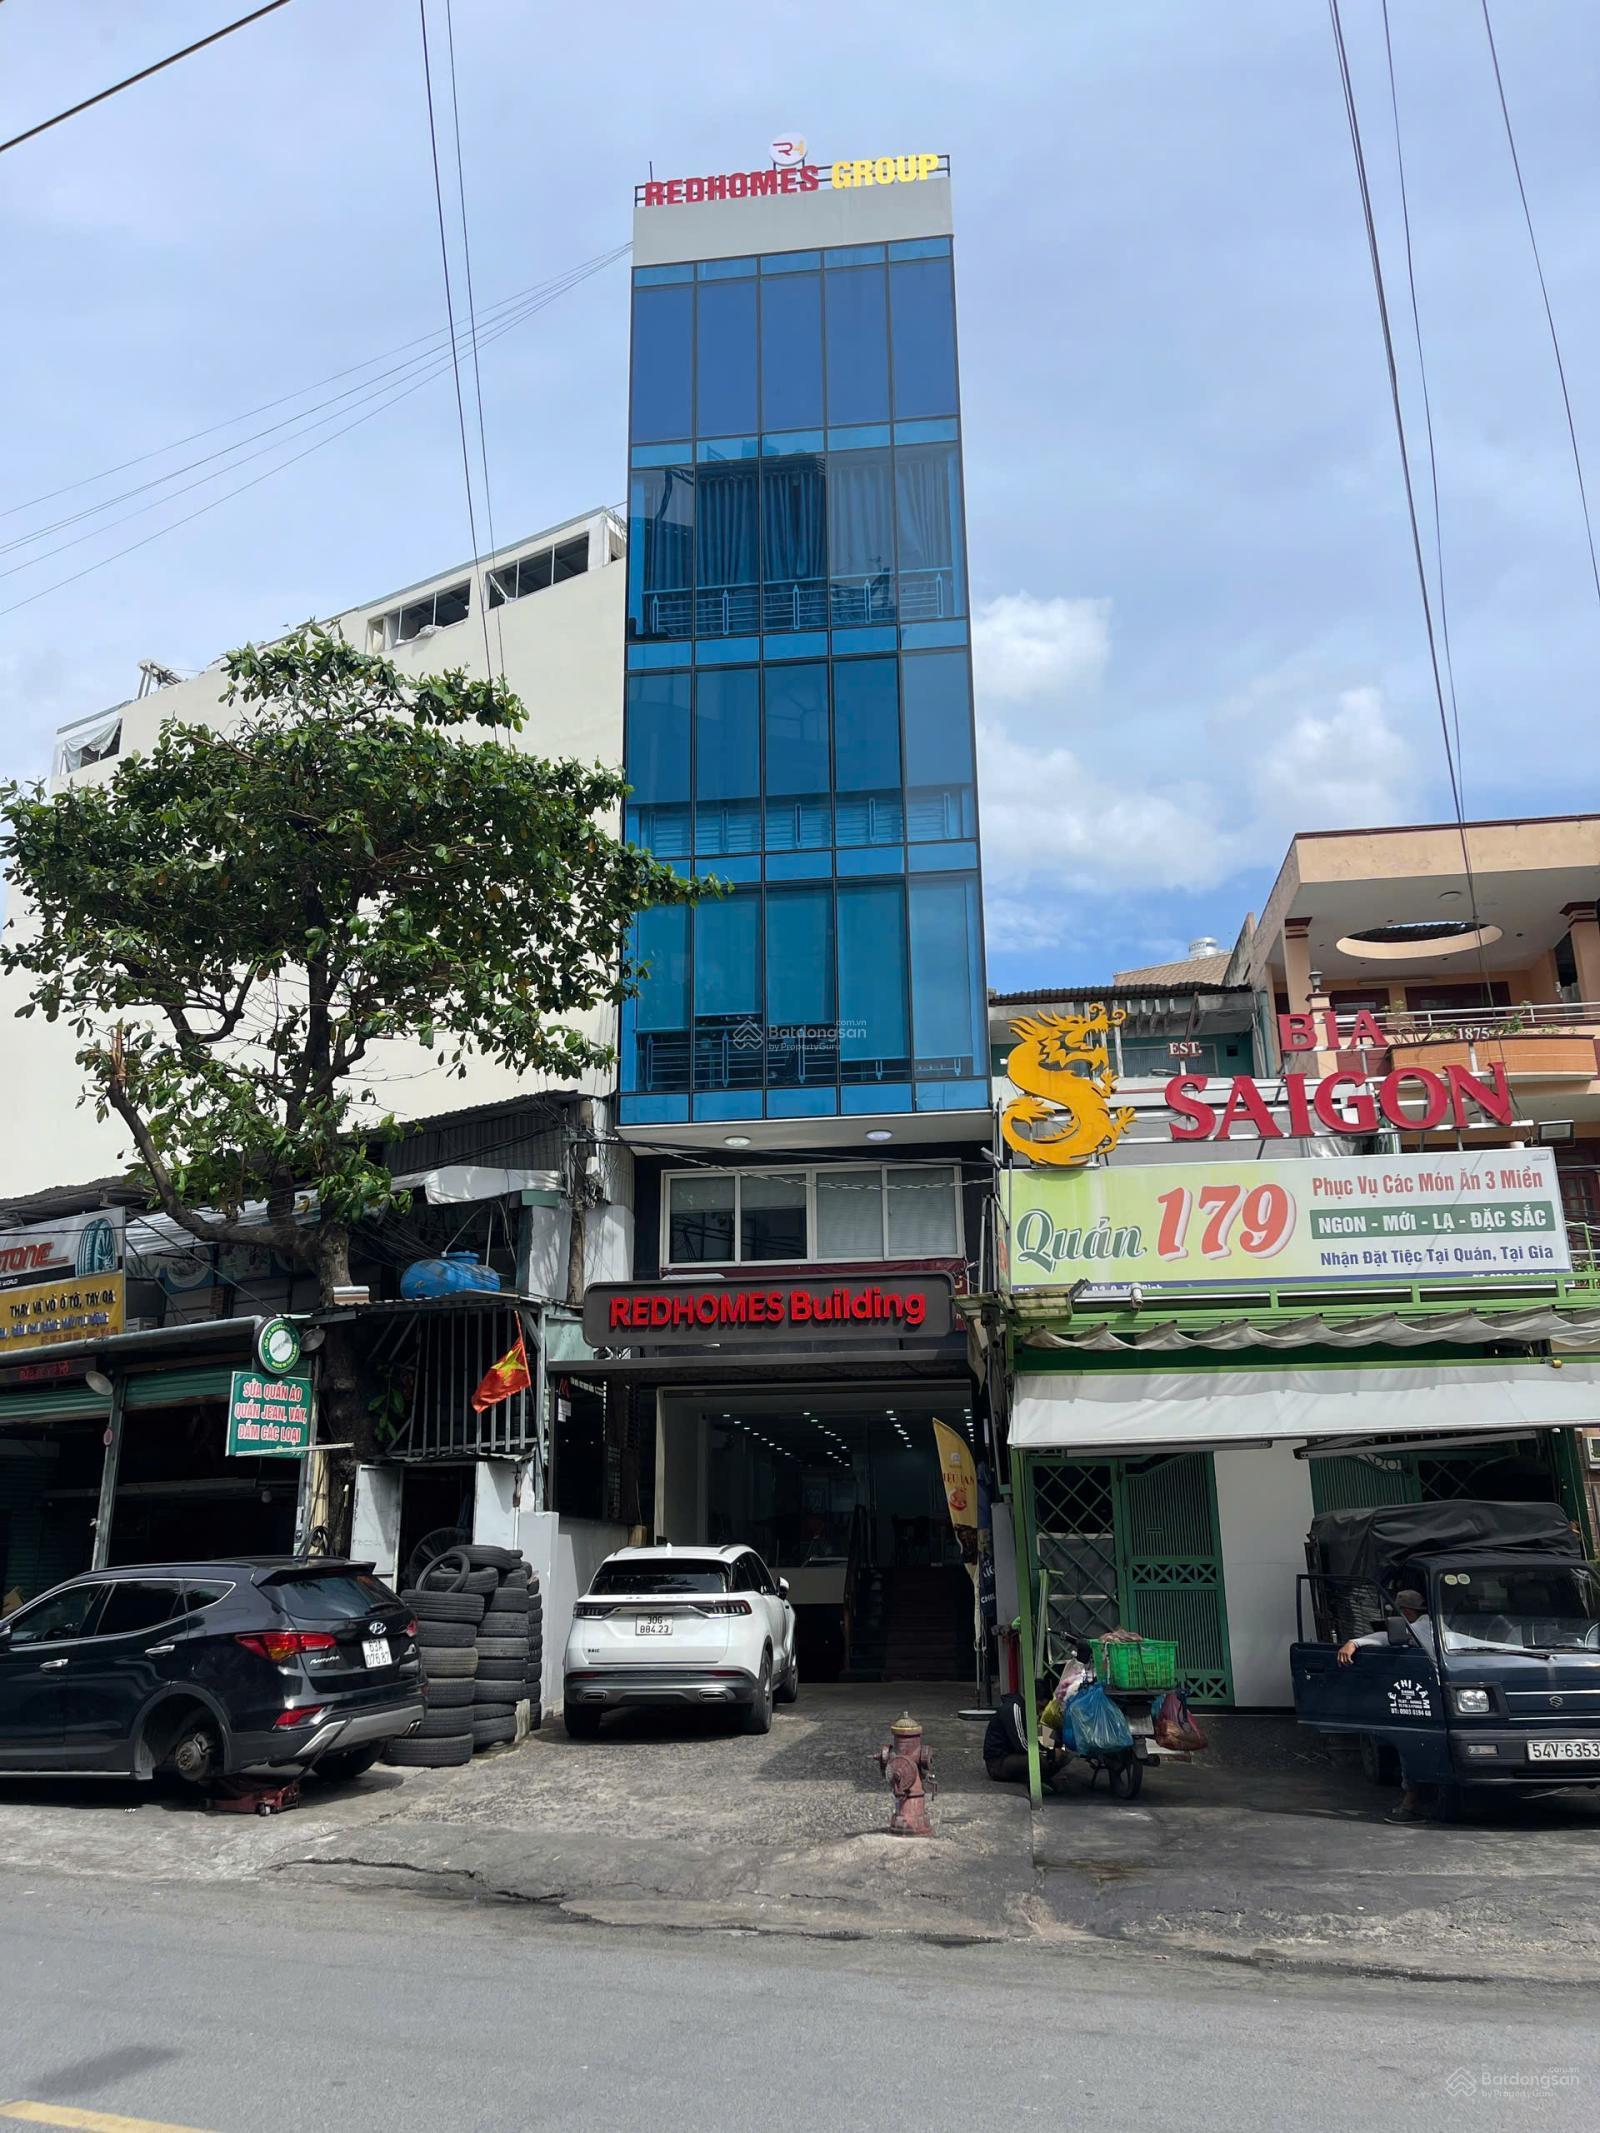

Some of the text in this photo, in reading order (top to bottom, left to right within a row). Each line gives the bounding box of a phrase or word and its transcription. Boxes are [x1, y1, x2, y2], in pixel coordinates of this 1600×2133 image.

[645, 153, 939, 206] REDHOMES GROUP
[1277, 1010, 1388, 1051] BIA
[1458, 1027, 1490, 1041] 1875
[1169, 1042, 1203, 1055] EST.
[1165, 1061, 1513, 1141] SAIGON
[1312, 1166, 1543, 1199] Phục Vụ Các Món Ăn 3 Miền
[1157, 1183, 1297, 1261] 179
[1318, 1216, 1367, 1234] NGON
[1383, 1211, 1416, 1231] MỚI
[1433, 1213, 1455, 1232] LẠ
[1470, 1207, 1506, 1231] ĐẶC
[1511, 1203, 1546, 1227] SẮC
[1320, 1245, 1554, 1267] Nhận Đặt Tiệc Tại Quán, Tại Gia
[610, 1286, 926, 1327] REDHOMES Building
[1532, 1743, 1600, 1759] 54V-6353
